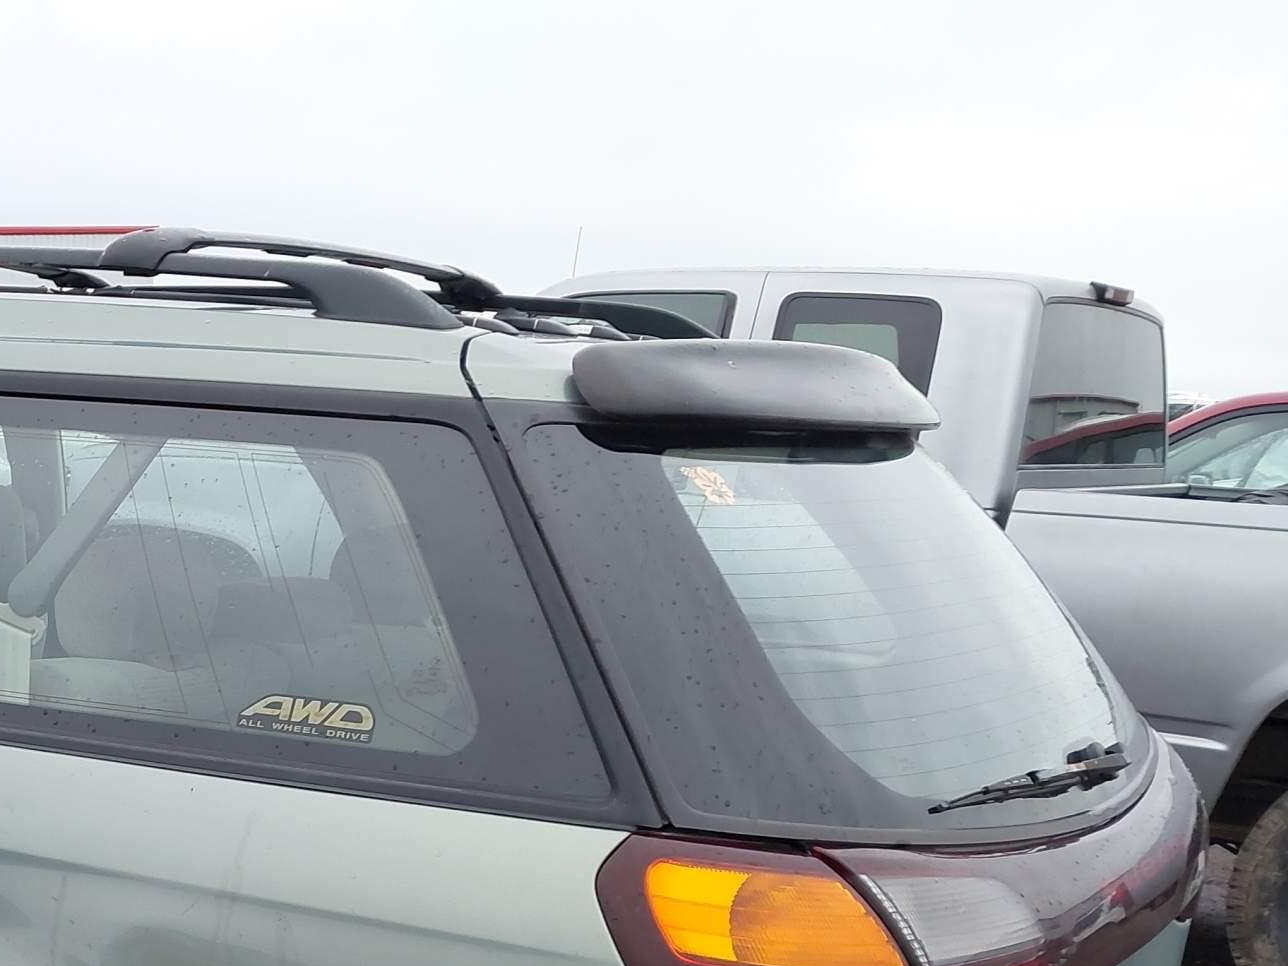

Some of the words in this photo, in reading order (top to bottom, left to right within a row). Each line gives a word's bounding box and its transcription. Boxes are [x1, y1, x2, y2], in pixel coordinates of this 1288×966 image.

[240, 695, 374, 730] AWD
[239, 718, 265, 728] ALL
[272, 722, 319, 735] WHEEL
[326, 730, 370, 741] DRIVE
